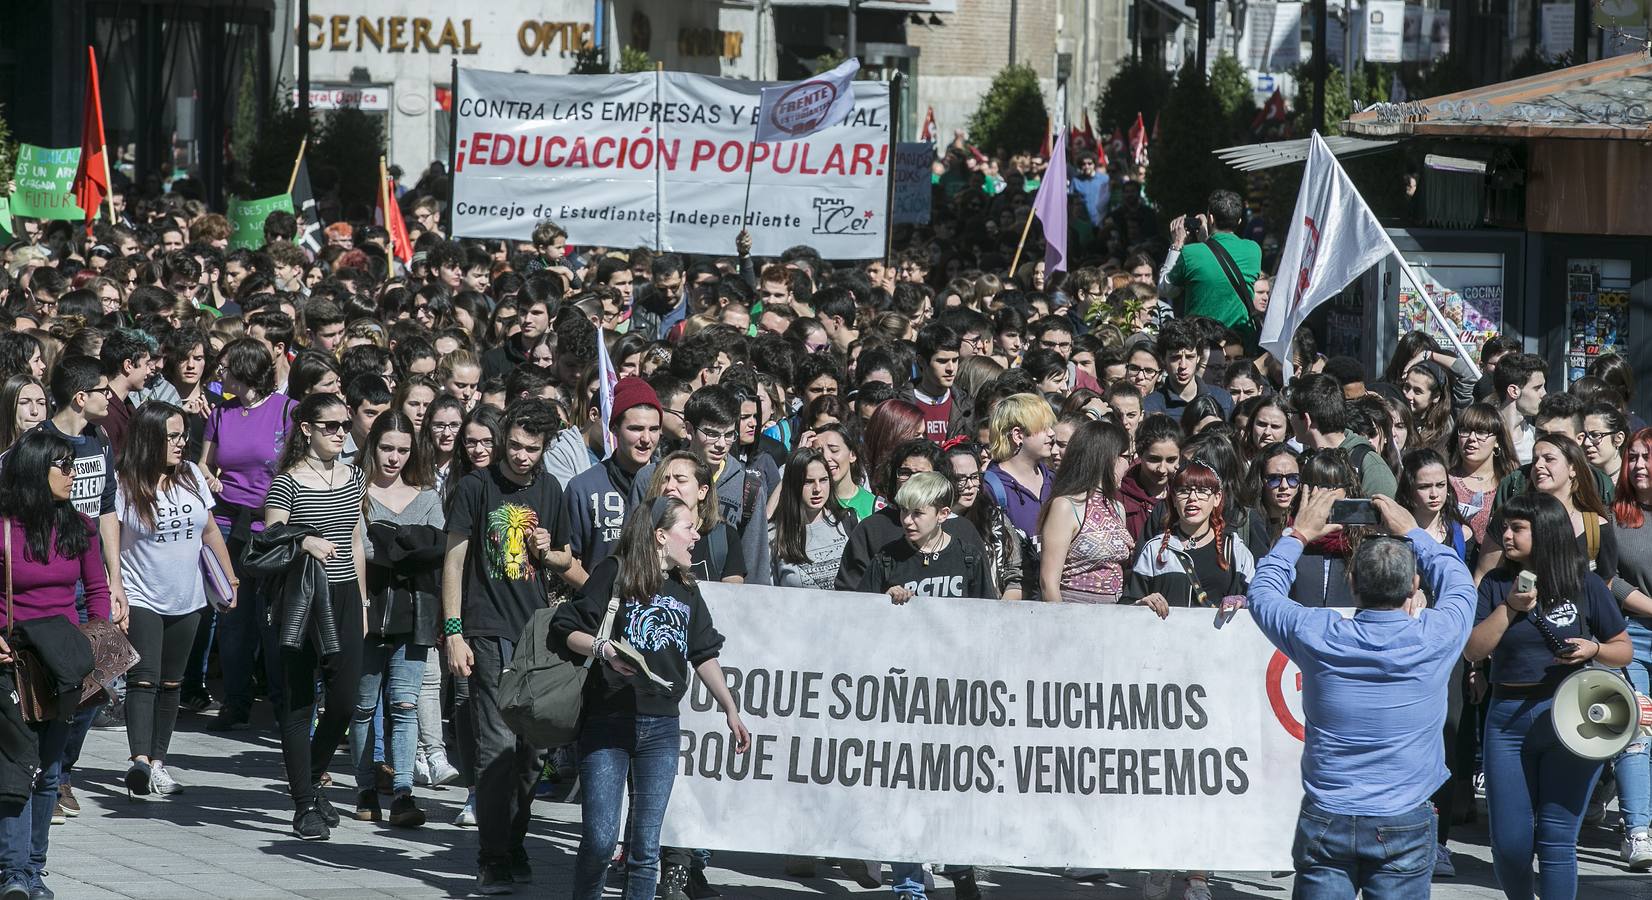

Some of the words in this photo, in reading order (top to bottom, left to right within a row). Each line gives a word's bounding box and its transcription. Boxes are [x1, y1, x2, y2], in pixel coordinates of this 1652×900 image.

[294, 15, 481, 55] GENERAL
[459, 97, 545, 120] CONTRA
[552, 102, 594, 121] LAS
[602, 102, 721, 124] EMPRESAS
[731, 105, 745, 125] Y
[779, 87, 829, 115] FRENTE
[20, 145, 32, 161] LA
[455, 126, 681, 173] ¡EDUCACIÓN
[690, 139, 889, 176] POPULAR!
[17, 163, 29, 175] ES
[33, 167, 47, 177] UN
[56, 166, 77, 178] ARM
[20, 179, 56, 190] CARGADA
[25, 191, 71, 208] FUTUR
[456, 202, 526, 220] Concejo
[533, 204, 553, 218] de
[560, 206, 662, 223] Estudiantes
[669, 209, 801, 228] Independiente
[824, 206, 875, 234] Cei
[157, 504, 192, 517] CHO
[156, 517, 194, 531] COL
[156, 529, 193, 543] ATE
[904, 575, 964, 597] RCTIC
[687, 666, 824, 719] ORQUE
[828, 666, 1017, 727] SOÑAMOS:
[1026, 679, 1209, 730] LUCHAMOS
[679, 729, 777, 782] RQUE
[787, 735, 1005, 795] LUCHAMOS:
[1013, 745, 1250, 796] VENCEREMOS
